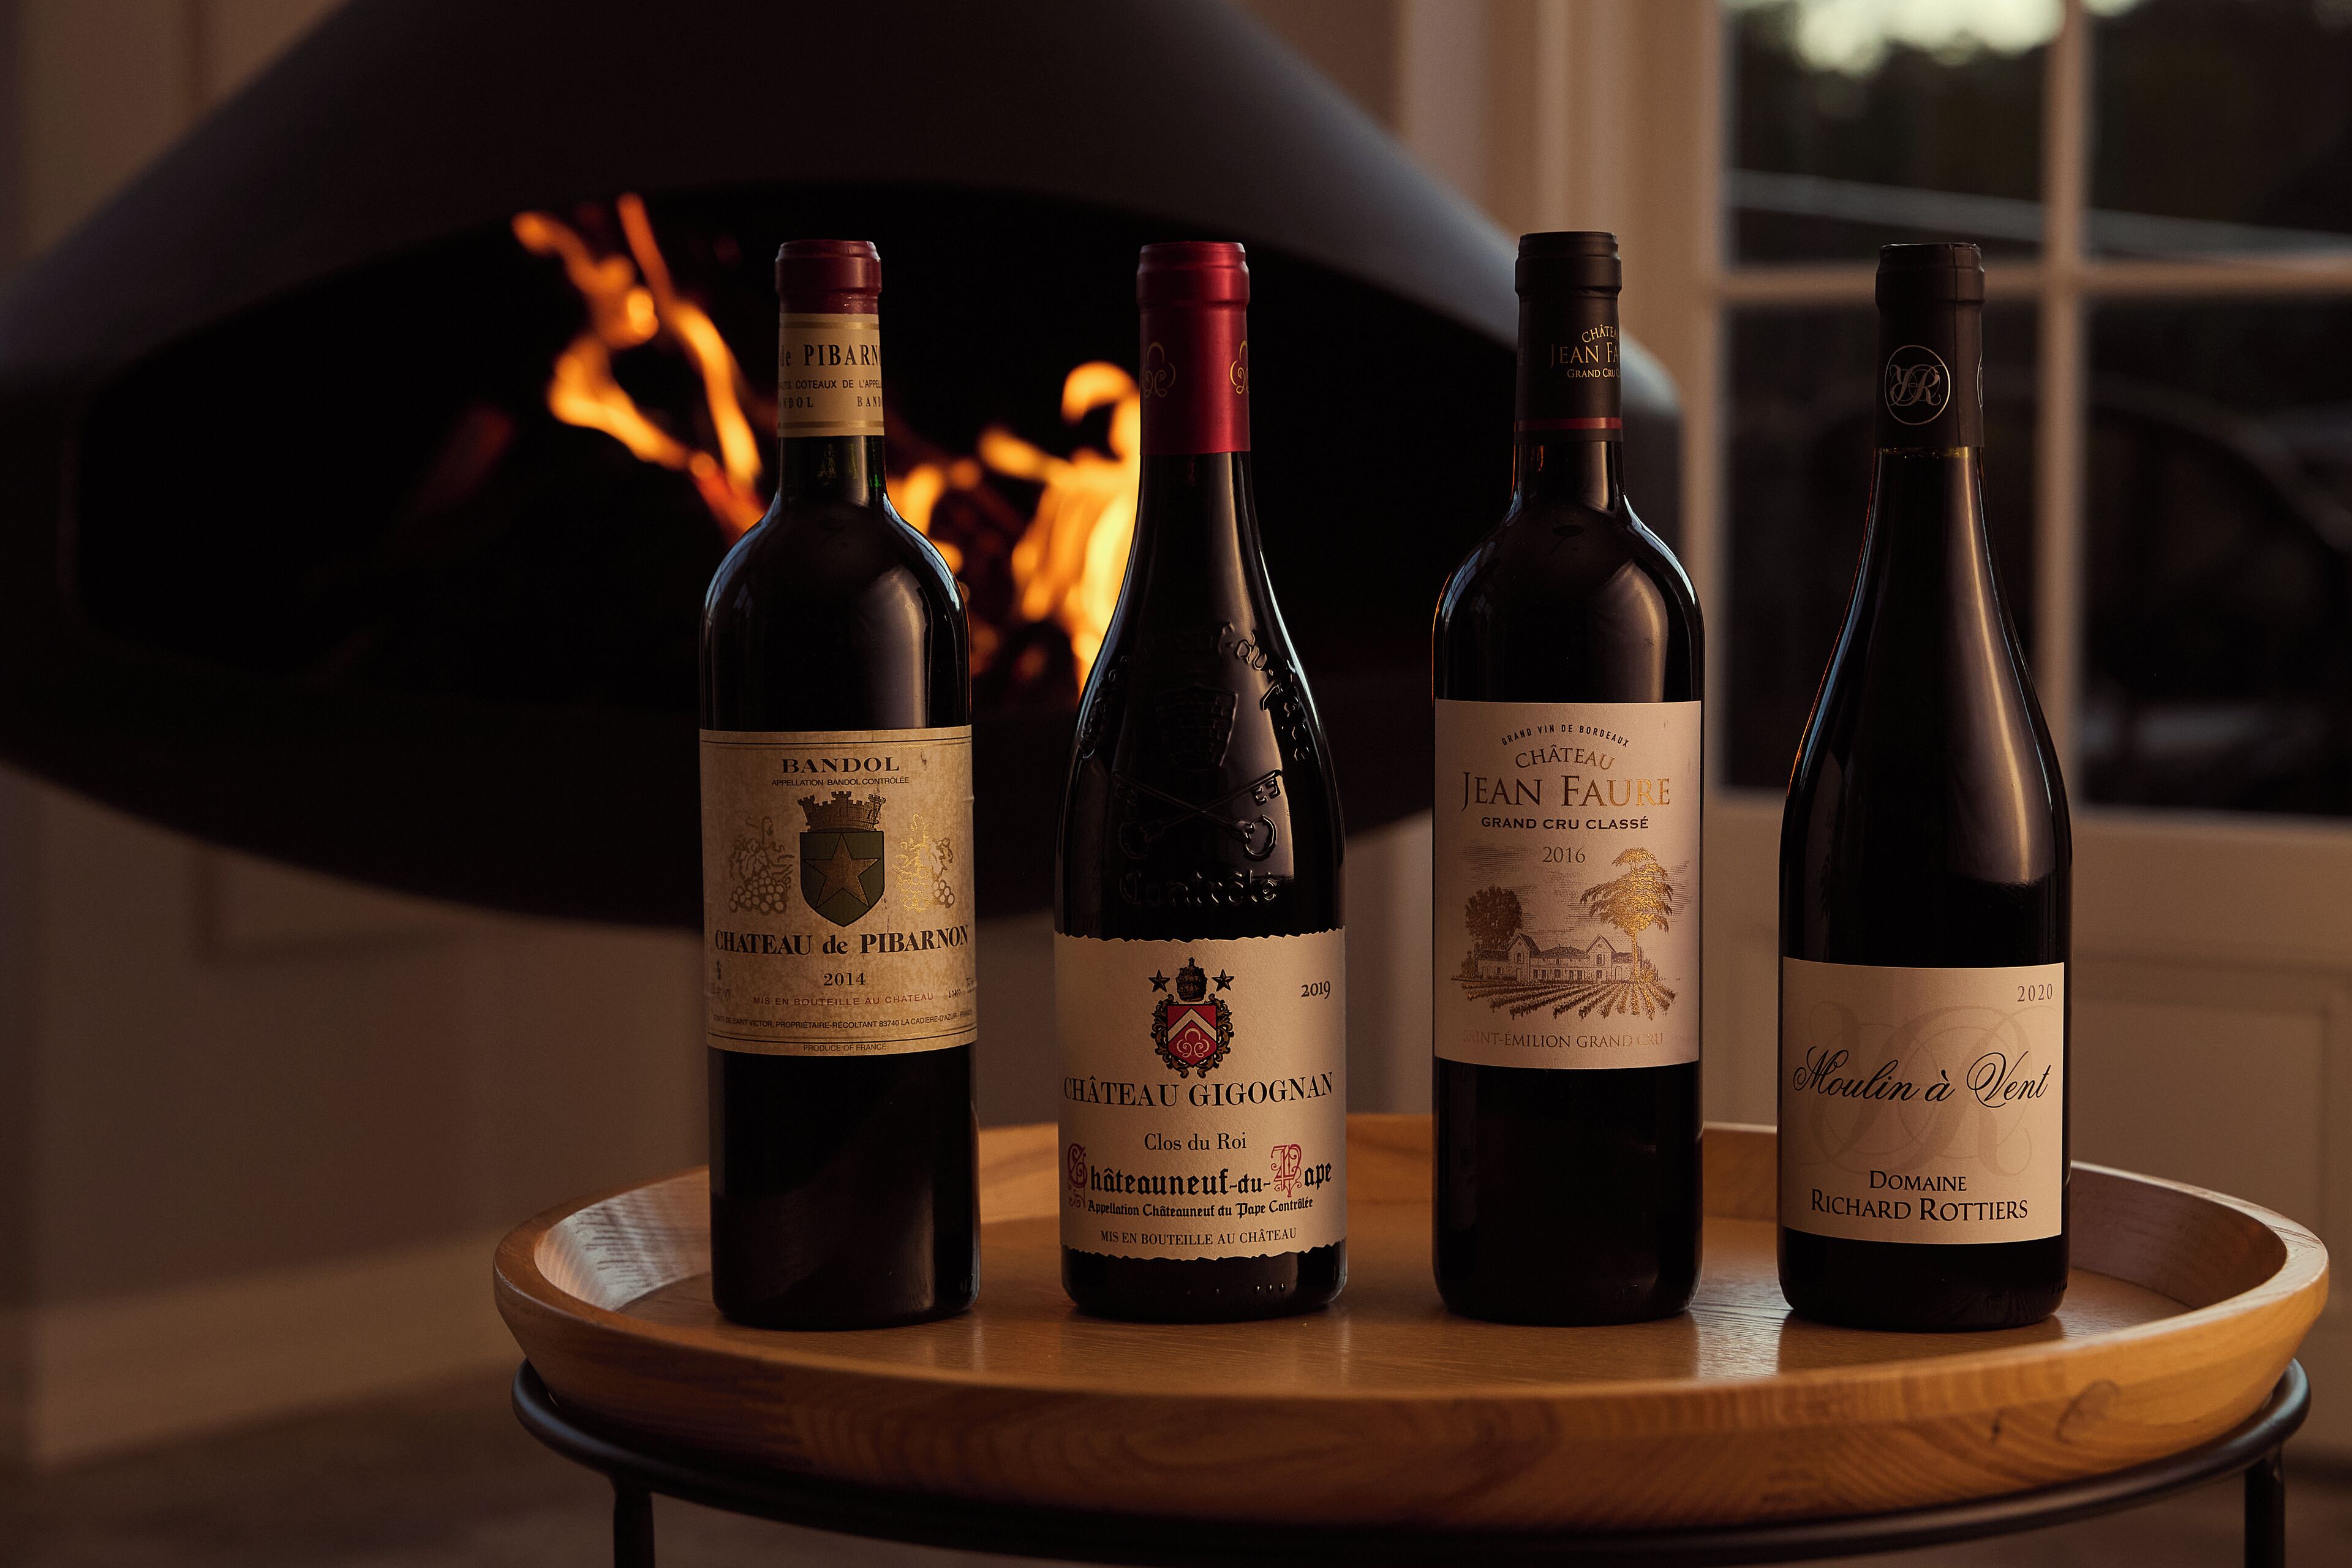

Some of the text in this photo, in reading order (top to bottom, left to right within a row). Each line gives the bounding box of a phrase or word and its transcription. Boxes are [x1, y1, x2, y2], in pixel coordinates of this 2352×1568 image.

[1581, 324, 1618, 343] CHÂTEA
[804, 344, 881, 366] PIBARN
[1549, 344, 1599, 369] JEAN
[1567, 368, 1600, 379] GRAND
[1602, 368, 1615, 377] CRU
[796, 380, 837, 389] COTEAUX
[842, 379, 854, 388] DE
[1502, 728, 1531, 745] GRAND
[1538, 725, 1554, 734] VIN
[1580, 725, 1629, 747] BORDEAUX
[782, 756, 900, 774] BANDOL
[1515, 744, 1615, 770] CHÂTEAU
[862, 776, 910, 785] CONTRÔLÉE
[1461, 772, 1670, 812] JEAN FAURE
[1482, 816, 1648, 829] GRAND CRU CLASSÉ
[1542, 846, 1585, 863] 2016
[715, 924, 968, 955] CHATEAU de PIBARNON
[823, 972, 865, 986] 2014
[885, 993, 933, 1003] CHATEAU
[1301, 981, 1330, 1000] 2019
[2018, 984, 2052, 1001] 2020
[1577, 1035, 1632, 1047] GRAND
[1637, 1033, 1662, 1046] CRU
[1793, 1046, 2051, 1108] Moulin à Vent
[1064, 1072, 1333, 1107] CHÂTEAU GIGOGNAN
[1144, 1132, 1246, 1150] Clos du Roi
[1088, 1197, 1313, 1218] Appellation Châteauneuf du Pape Contrôlée
[1101, 1227, 1297, 1245] MIS EN BOUTEILLE AU CHÂTEAU
